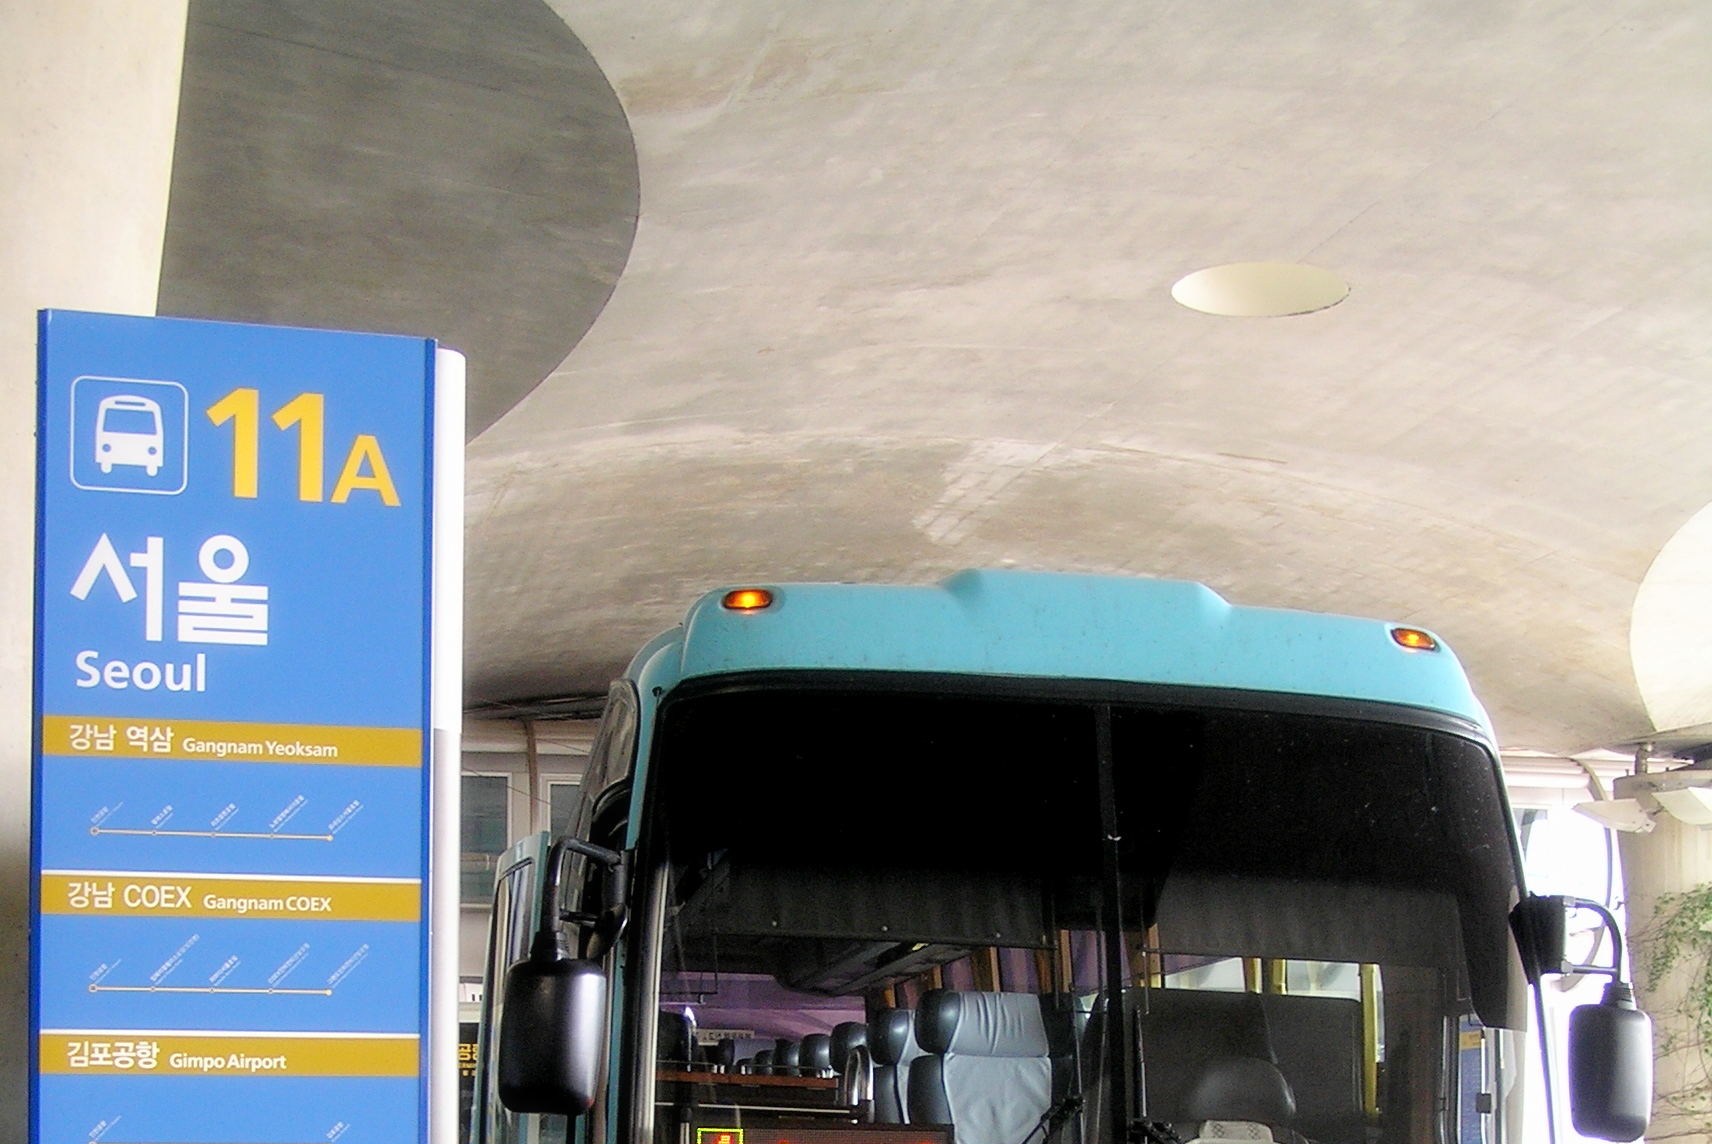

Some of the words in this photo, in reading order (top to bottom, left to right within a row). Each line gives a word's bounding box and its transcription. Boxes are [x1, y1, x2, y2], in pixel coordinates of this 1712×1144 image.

[206, 388, 402, 507] 11A
[70, 533, 268, 645] 서울
[76, 651, 205, 691] Seoul
[69, 724, 116, 752] 강남
[125, 726, 174, 753] 역삼
[182, 738, 263, 756] Gangnam
[266, 741, 337, 756] Yeoksam
[68, 882, 114, 908] 강남
[124, 885, 191, 907] COEX
[204, 895, 283, 913] Gangnam
[286, 897, 330, 911] COEX
[66, 1041, 160, 1070] 김포공항
[169, 1053, 226, 1070] Gimpo
[227, 1054, 287, 1072] Airport
